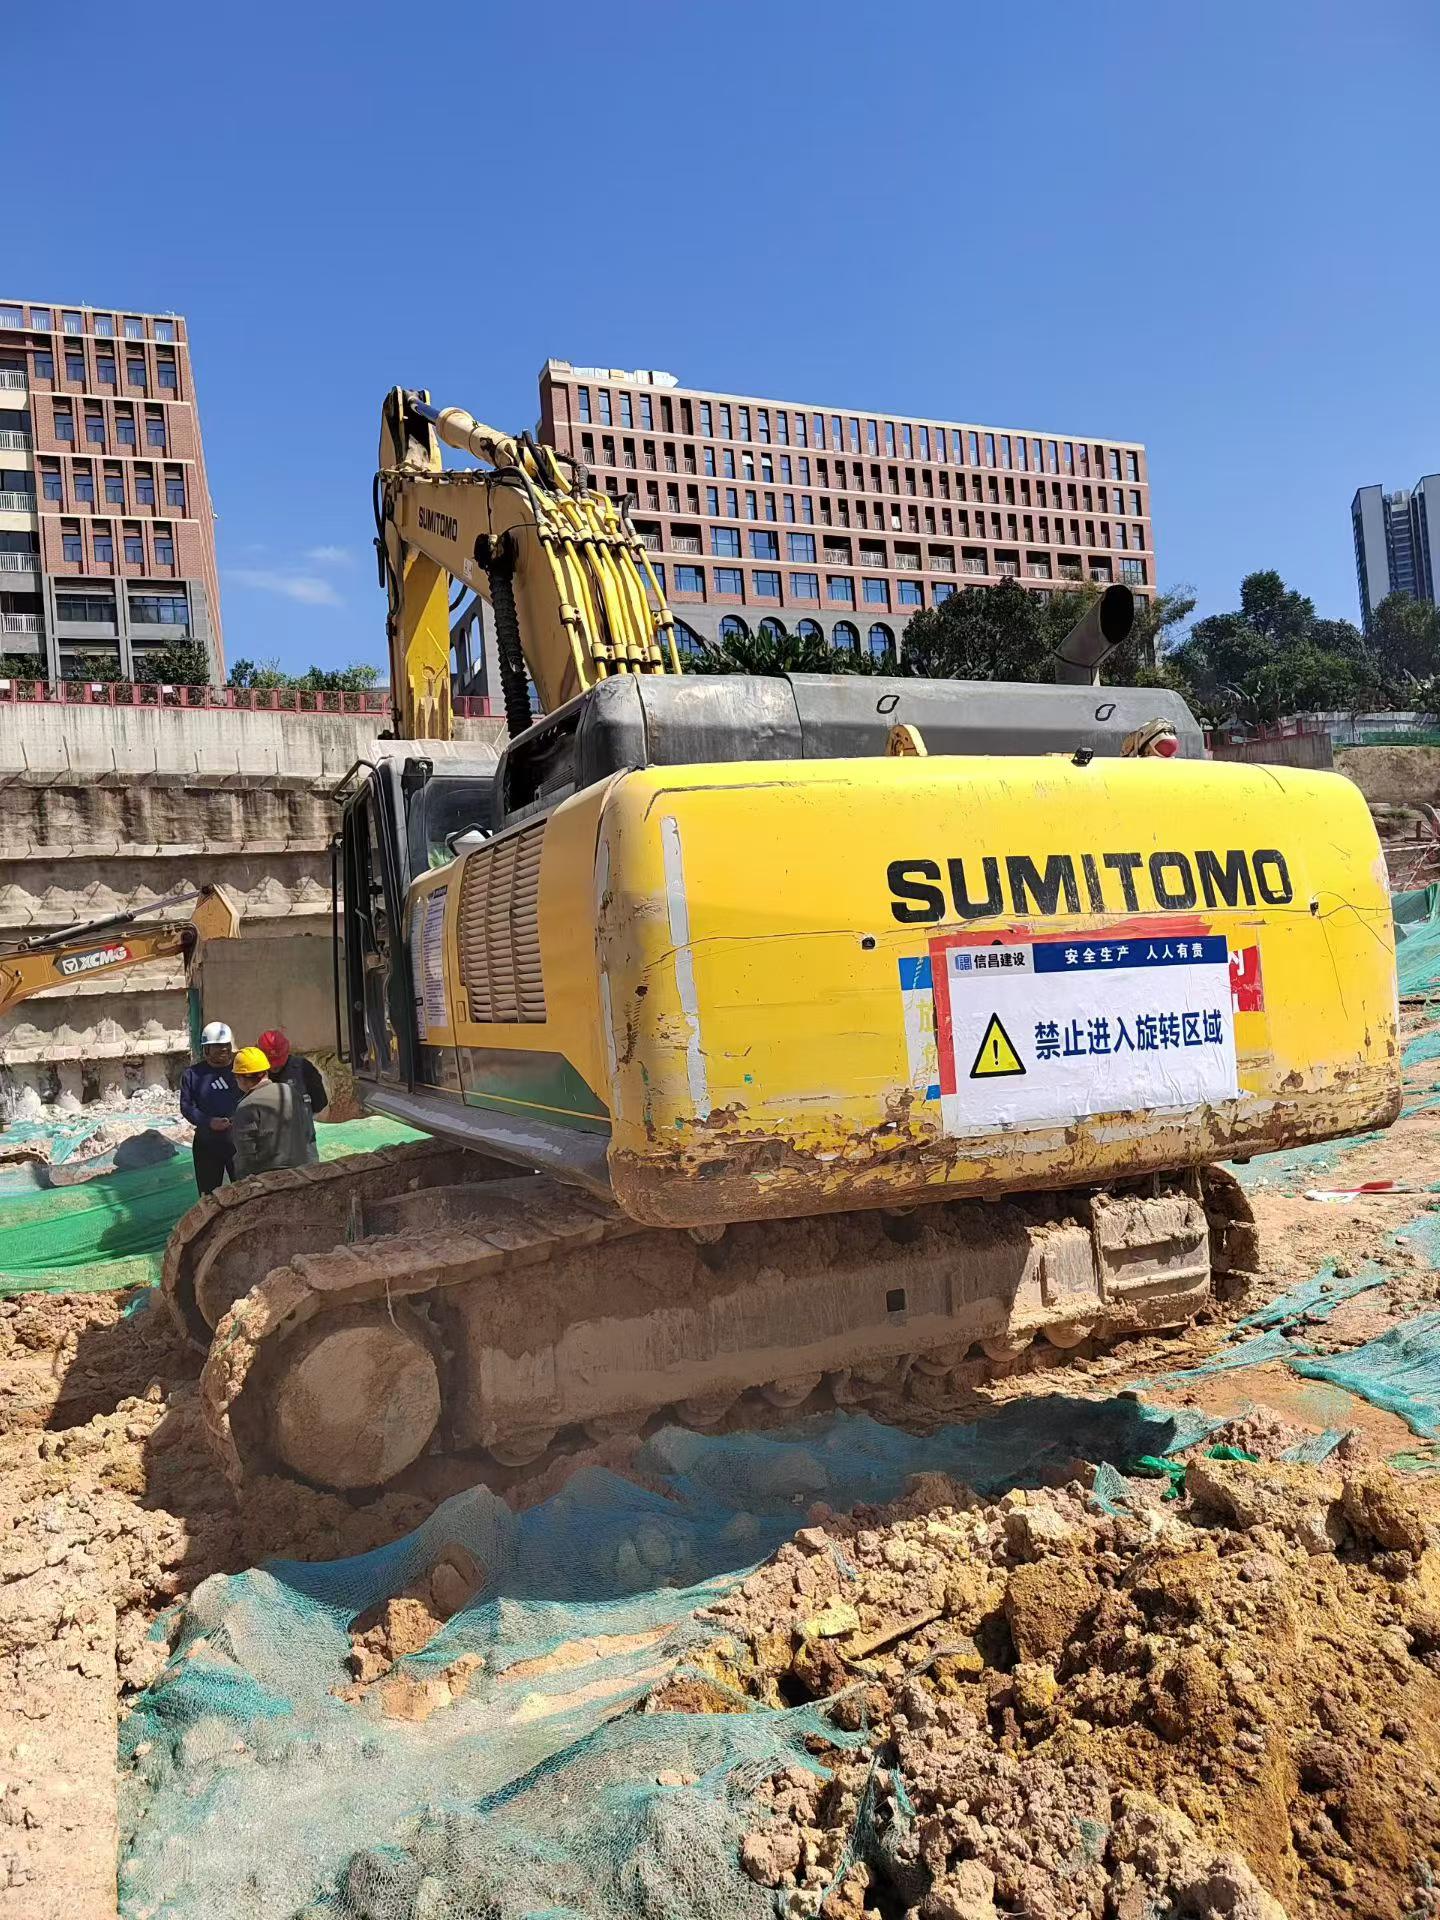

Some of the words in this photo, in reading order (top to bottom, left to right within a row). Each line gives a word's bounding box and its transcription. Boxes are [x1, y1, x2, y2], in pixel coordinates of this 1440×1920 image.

[418, 506, 458, 542] SUMITOMO
[887, 849, 1293, 923] SUMITOMO
[80, 946, 127, 970] XCMG
[973, 951, 1026, 969] 信昌建设
[1064, 946, 1130, 964] 安全生产
[1146, 942, 1204, 960] 人人有责
[1034, 1009, 1223, 1060] 禁止进入旋转区域
